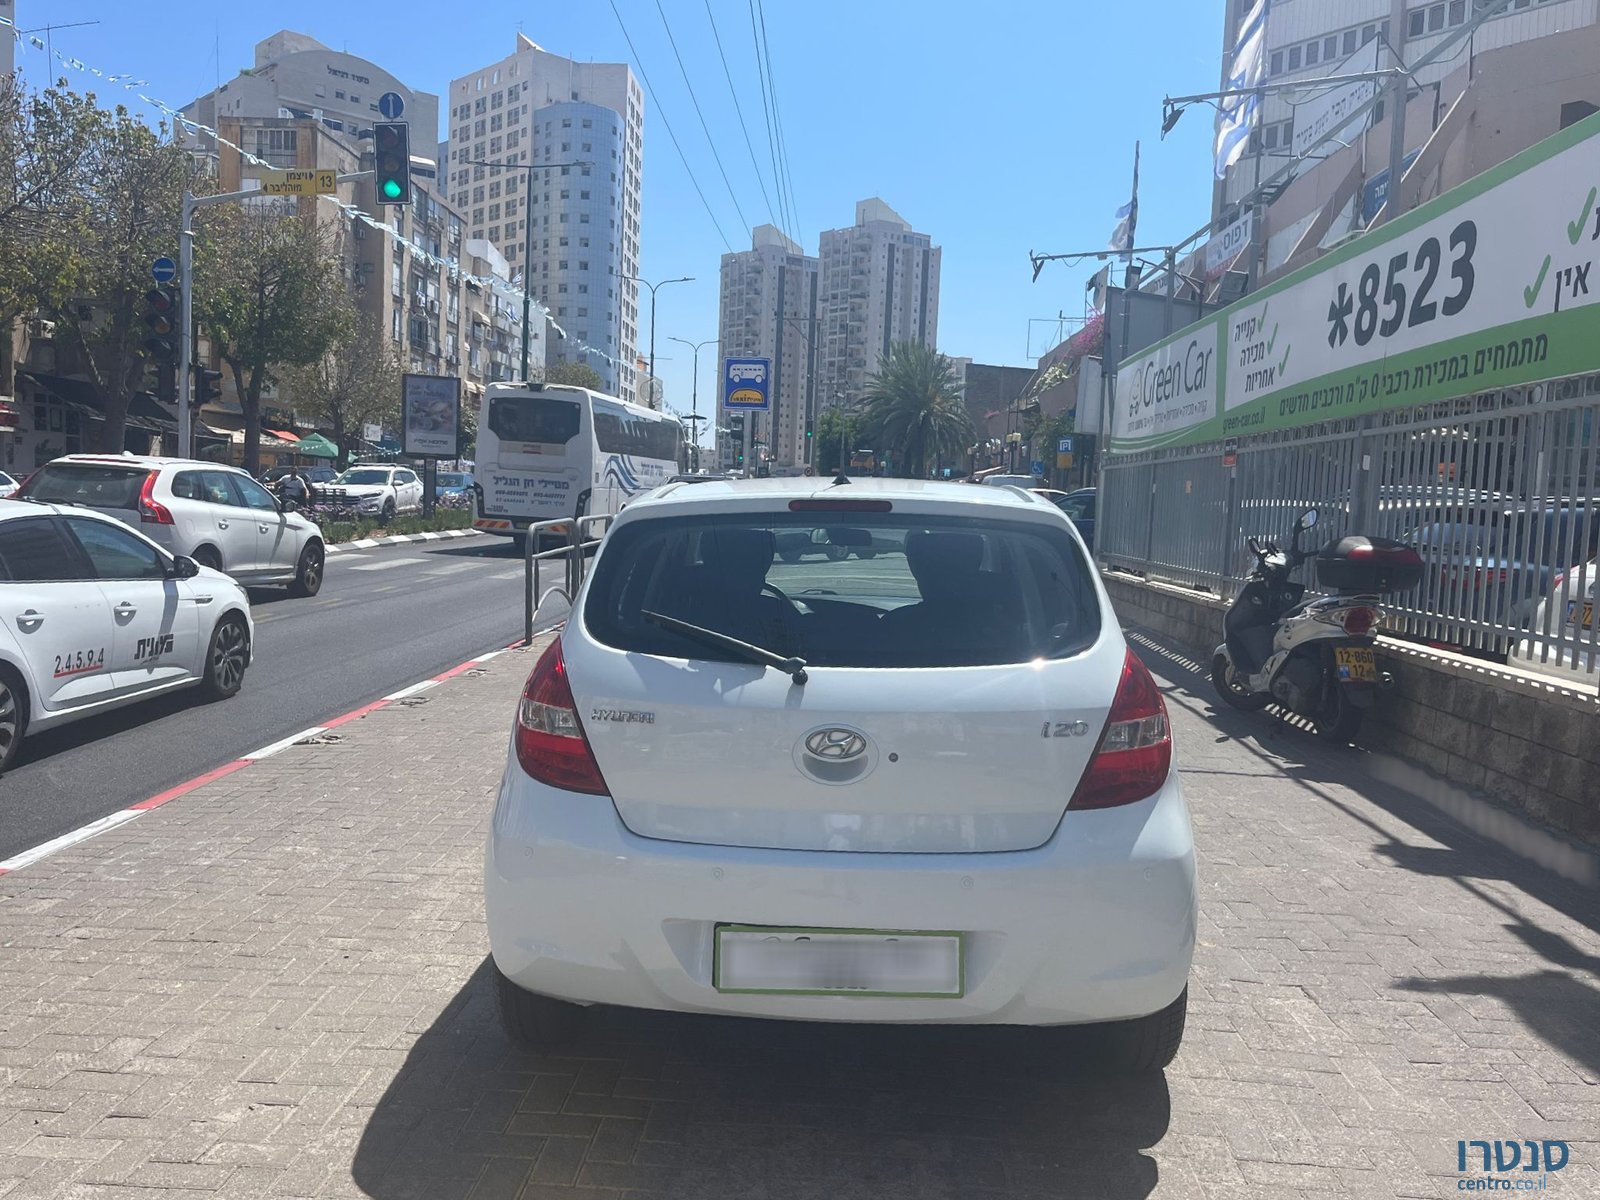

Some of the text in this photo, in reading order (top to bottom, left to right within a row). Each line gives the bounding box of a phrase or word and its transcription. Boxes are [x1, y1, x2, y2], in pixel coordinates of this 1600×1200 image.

[269, 182, 302, 192] מוהליבר
[286, 172, 308, 183] ויצמן
[319, 175, 333, 188] 13
[1223, 220, 1249, 250] דפוס
[1554, 261, 1592, 313] אין
[1234, 317, 1256, 342] קנייה
[1240, 341, 1265, 367] מכירה
[1473, 333, 1549, 376] מתמחים
[1143, 340, 1212, 408] Green Car
[1245, 366, 1276, 393] אחריות
[1382, 369, 1410, 396] רכבי
[1412, 354, 1468, 389] במכירת
[1279, 393, 1309, 417] חדשים
[1311, 384, 1344, 410] ורכבים
[591, 708, 656, 724] HYUNDAI
